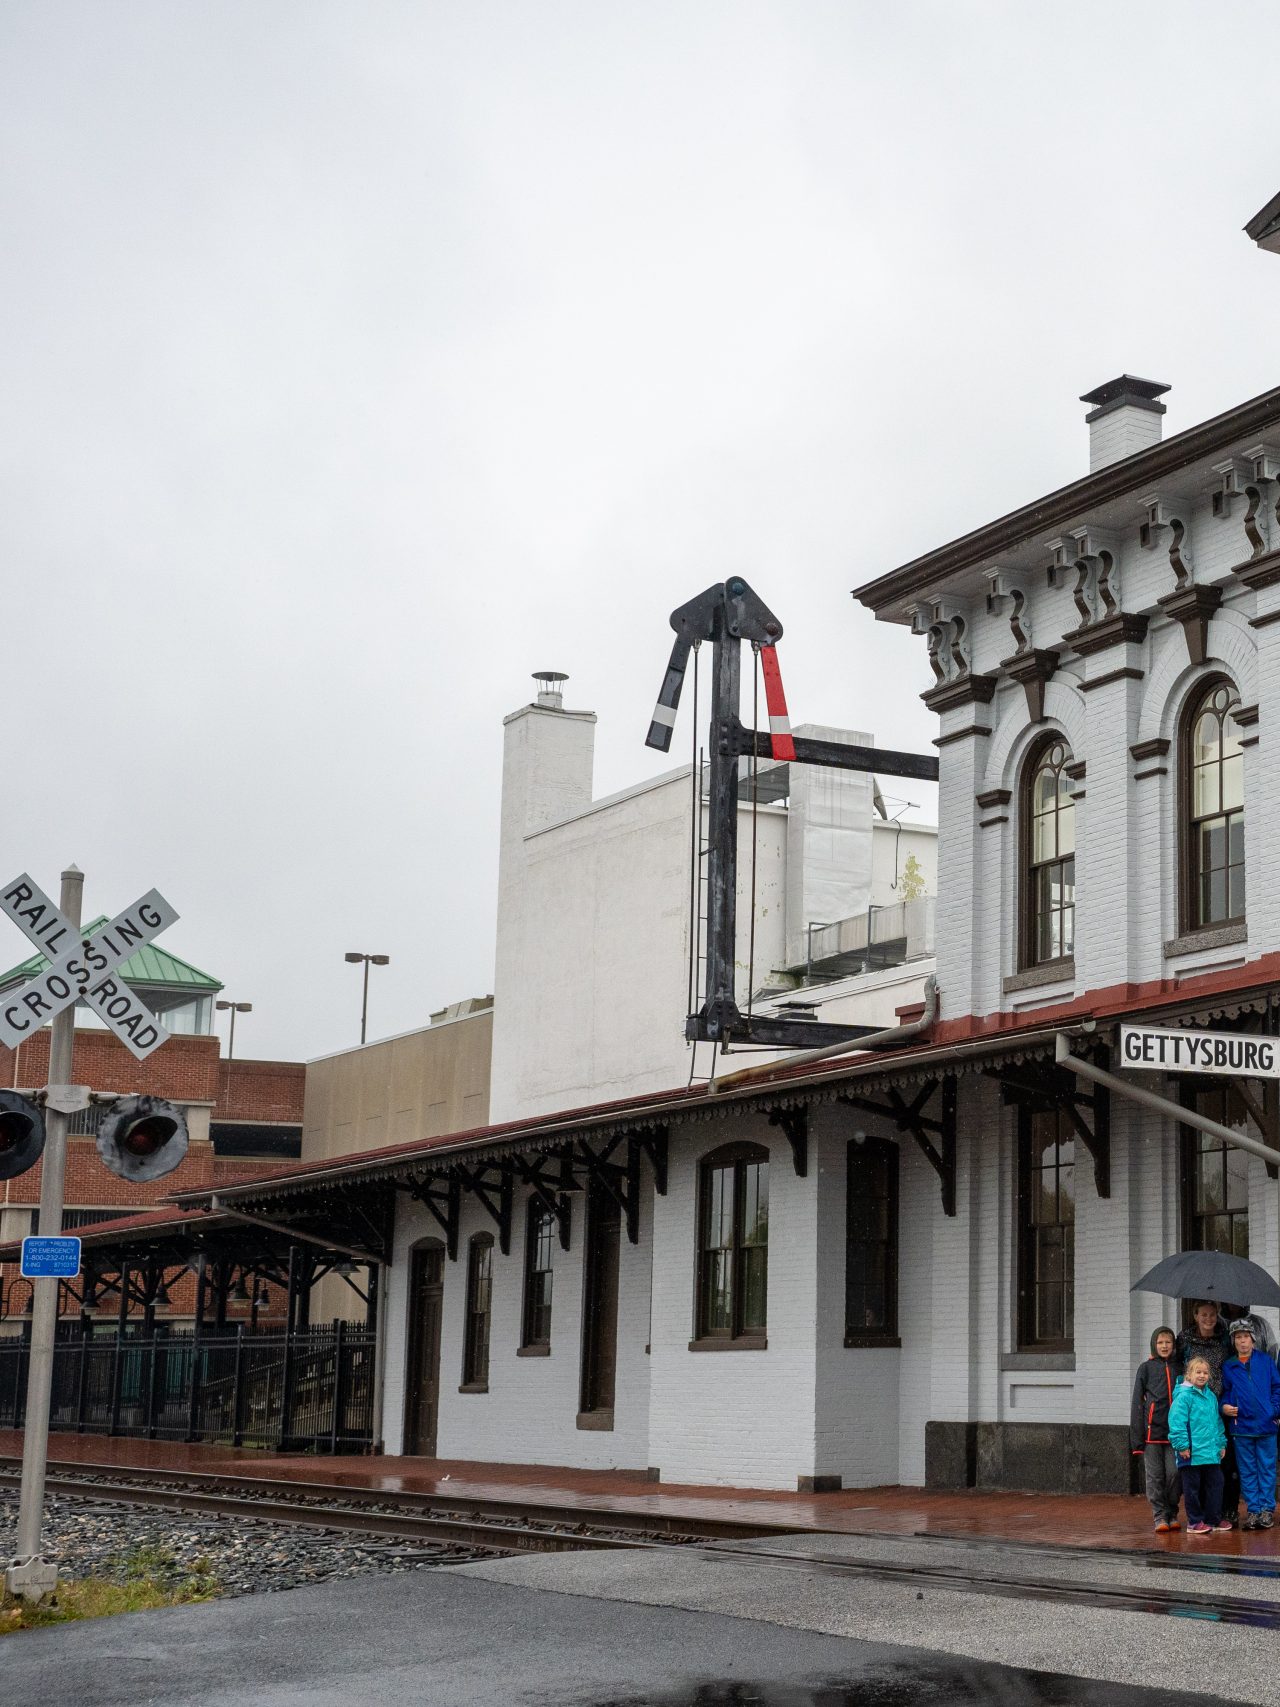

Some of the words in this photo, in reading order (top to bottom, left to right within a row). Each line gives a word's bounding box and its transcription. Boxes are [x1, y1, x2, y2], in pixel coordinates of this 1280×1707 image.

[4, 882, 67, 955] RAIL
[5, 904, 162, 1031] CROSSING
[90, 979, 158, 1049] ROAD
[1125, 1032, 1274, 1071] GETTYSBURG
